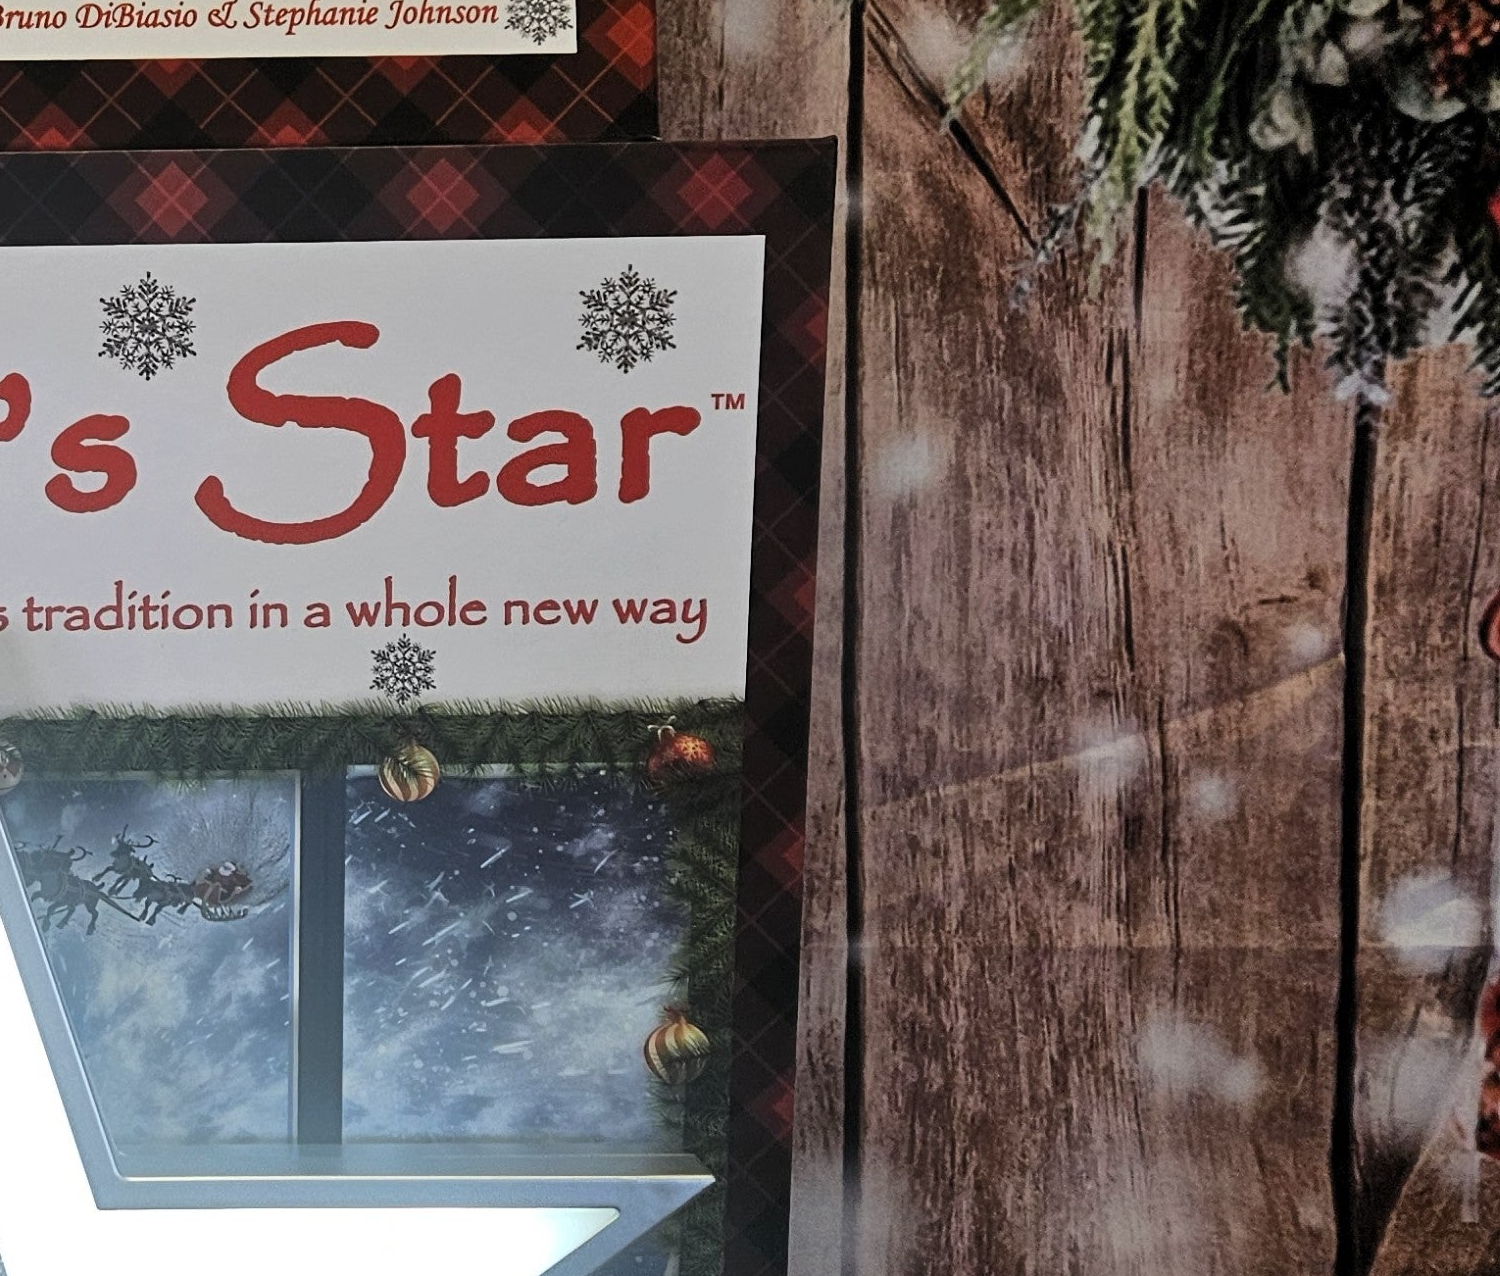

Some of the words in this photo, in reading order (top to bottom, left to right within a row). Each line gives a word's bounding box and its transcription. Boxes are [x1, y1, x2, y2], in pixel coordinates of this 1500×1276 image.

[76, 0, 199, 29] DiBiasio
[22, 579, 234, 633] tradition
[248, 588, 289, 629] in
[302, 601, 332, 629] a
[344, 574, 487, 629] whole
[503, 595, 599, 629] new
[611, 596, 708, 644] way
